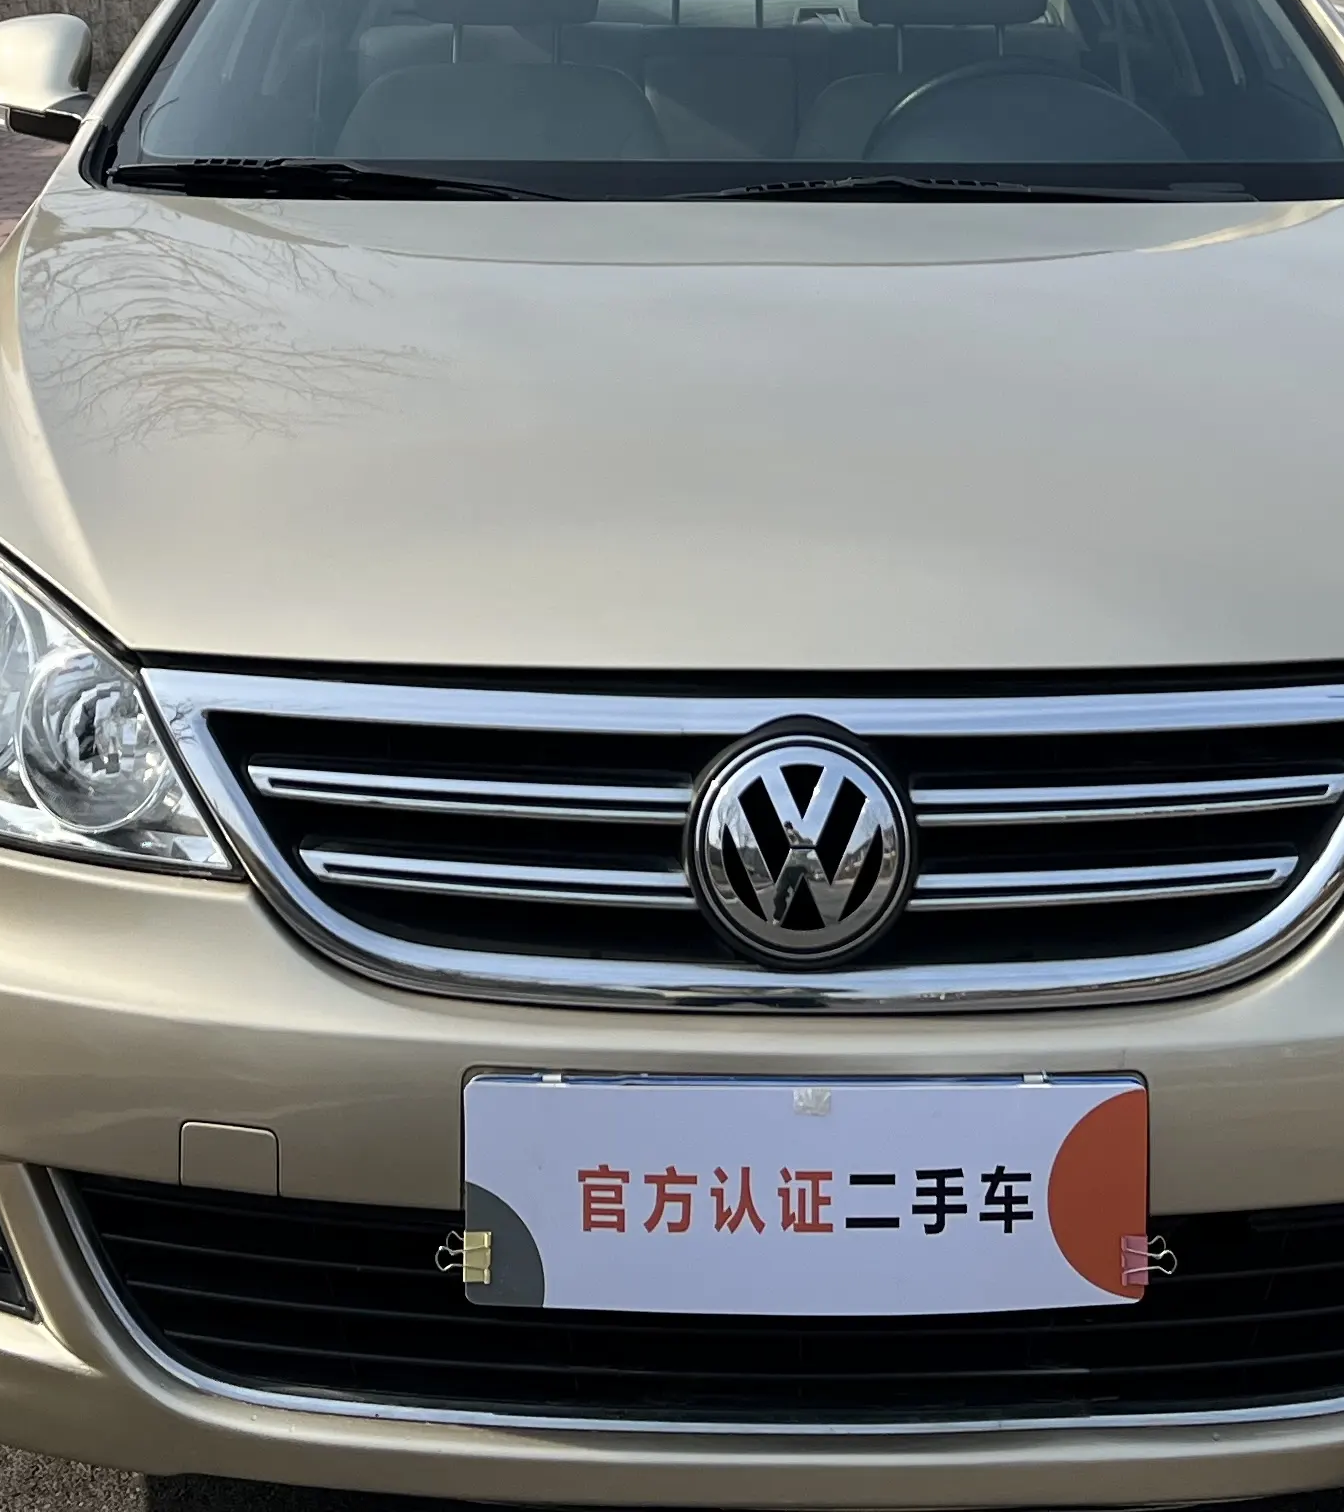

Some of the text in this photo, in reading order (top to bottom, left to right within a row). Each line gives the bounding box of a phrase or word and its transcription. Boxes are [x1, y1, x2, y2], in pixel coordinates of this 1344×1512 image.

[706, 744, 899, 949] VW
[577, 1164, 1035, 1235] 官方认证二手车
